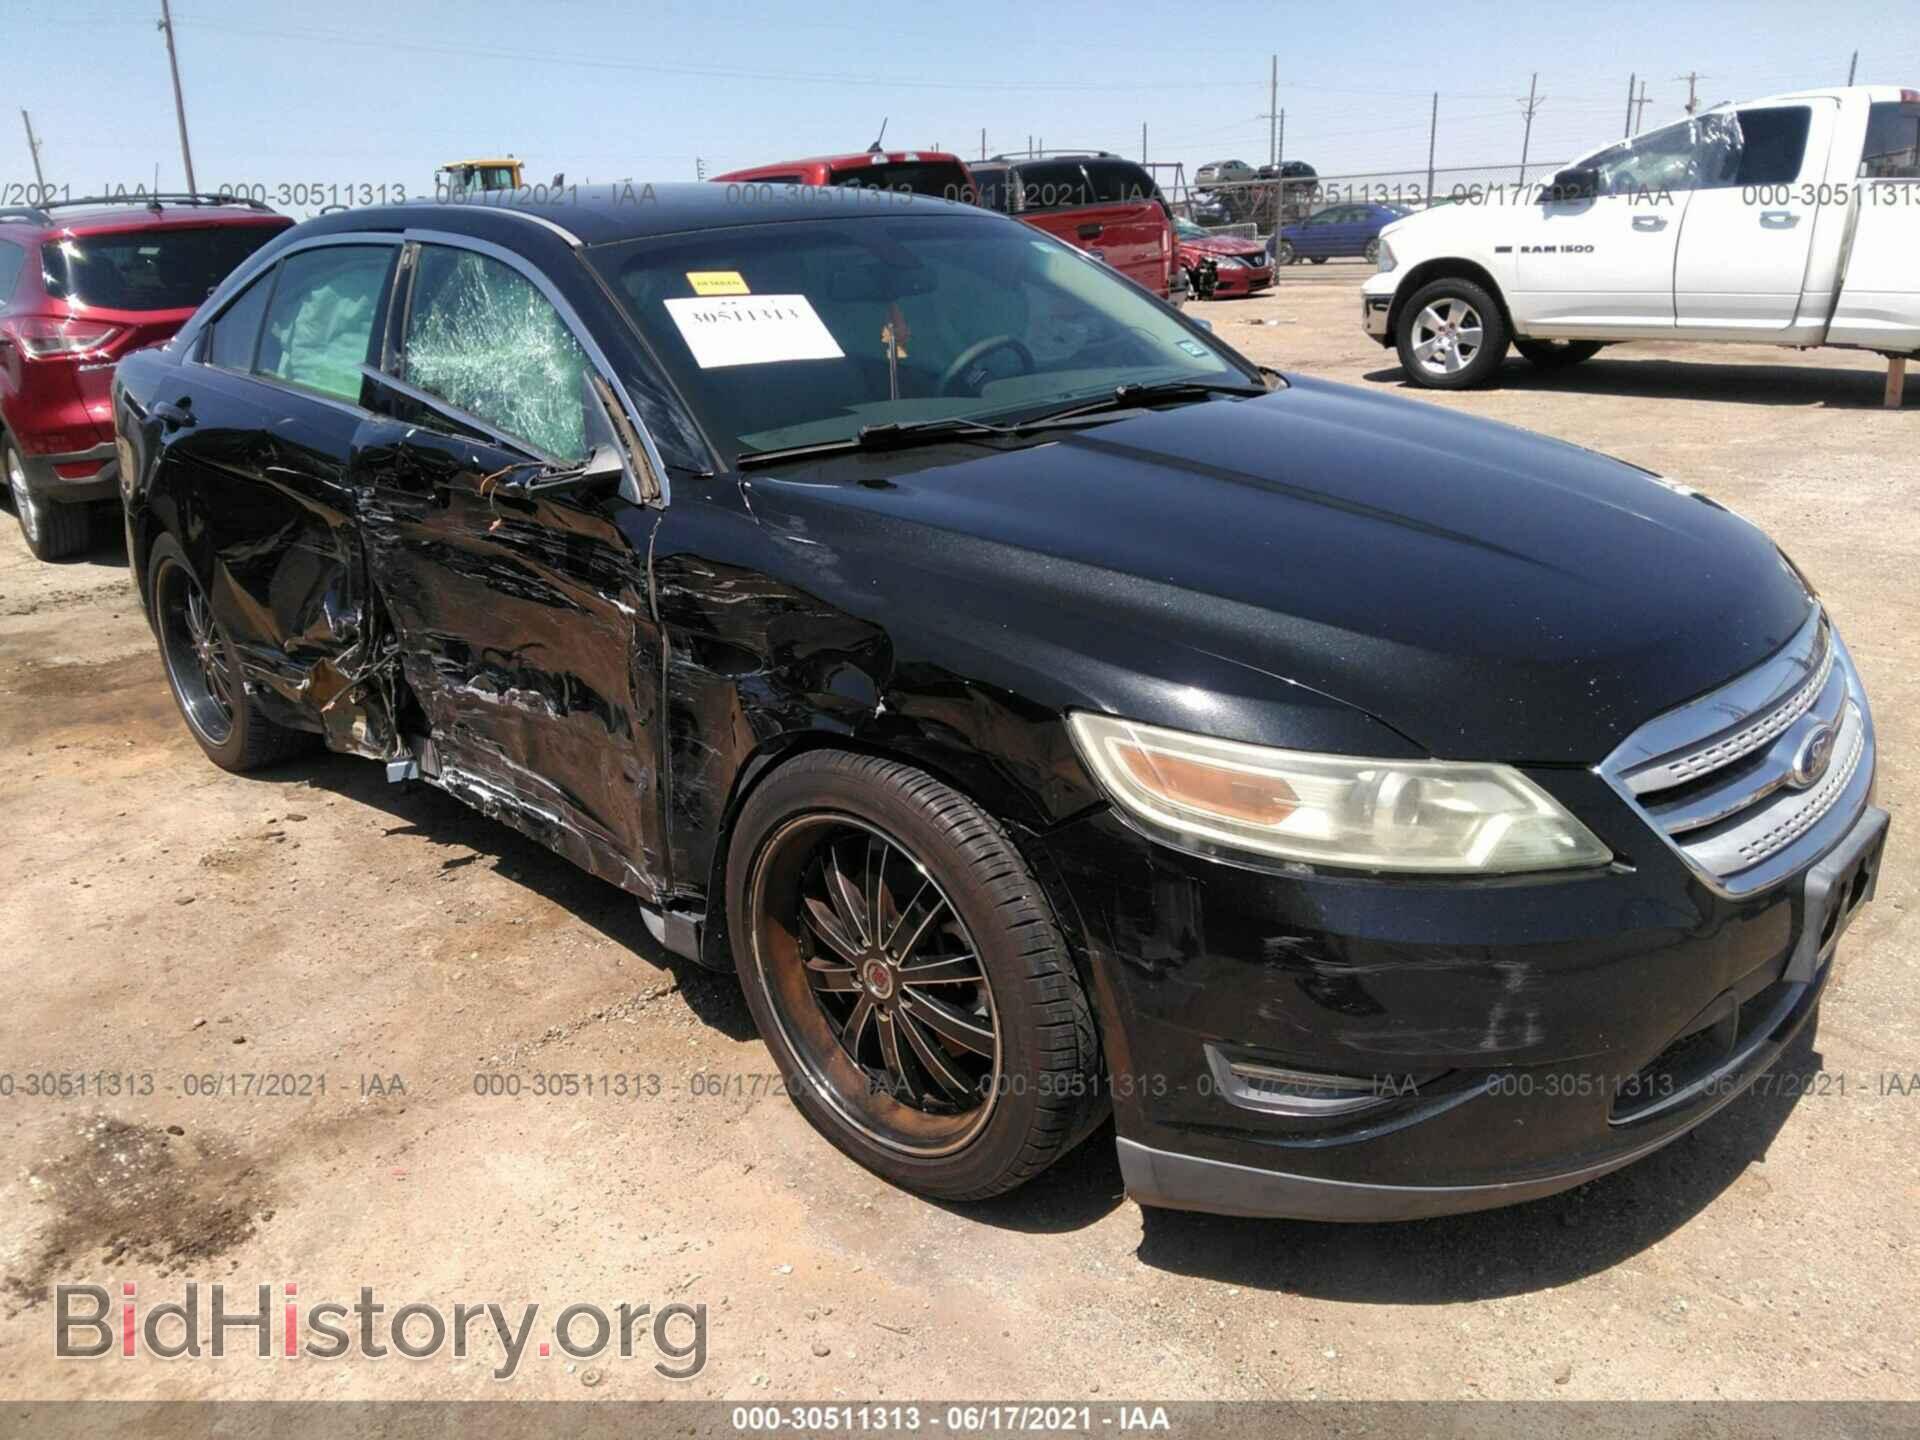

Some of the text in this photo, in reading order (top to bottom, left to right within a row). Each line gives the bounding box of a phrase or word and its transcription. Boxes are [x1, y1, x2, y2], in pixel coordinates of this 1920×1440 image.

[1521, 245, 1556, 254] RAM
[1560, 244, 1595, 254] 1500
[691, 307, 800, 324] 30511313
